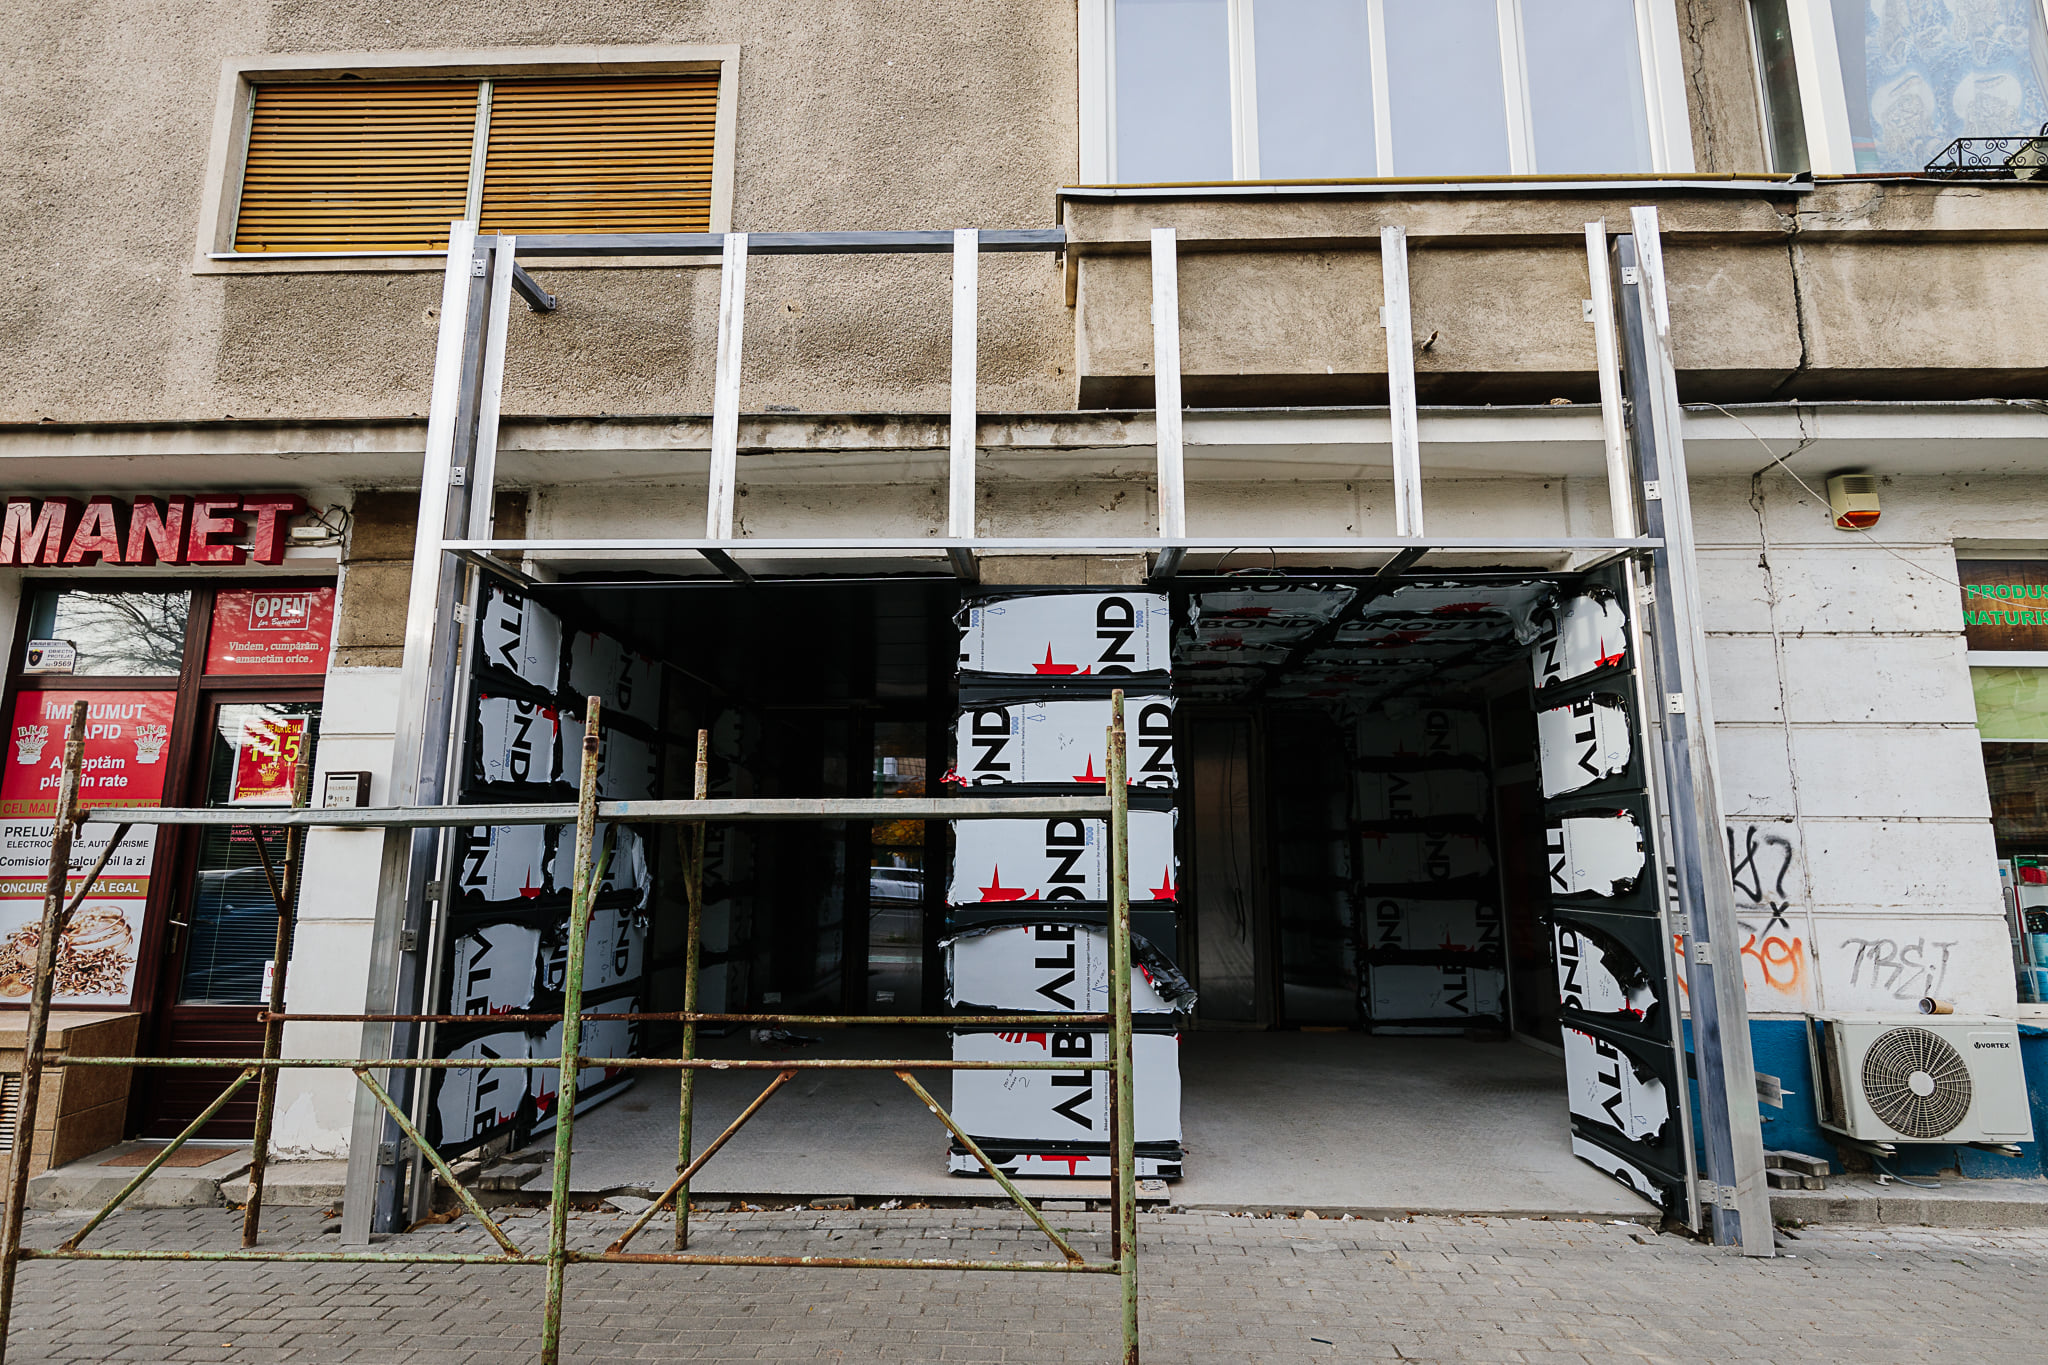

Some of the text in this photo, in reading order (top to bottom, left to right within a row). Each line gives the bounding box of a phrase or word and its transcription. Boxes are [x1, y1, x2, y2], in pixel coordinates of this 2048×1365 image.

[0, 497, 303, 566] MANET
[255, 598, 306, 617] OPEN
[257, 619, 268, 627] for
[1097, 596, 1136, 675] ND
[235, 654, 283, 663] amanetăm
[972, 706, 1012, 785] ND
[1138, 703, 1174, 787] ND
[50, 756, 125, 772] Aeptăm
[81, 773, 95, 787] în
[99, 774, 128, 787] rate
[3, 803, 25, 814] CEL
[28, 803, 50, 814] MAI
[123, 855, 134, 867] la
[136, 855, 146, 867] zi
[109, 882, 140, 894] EGAL
